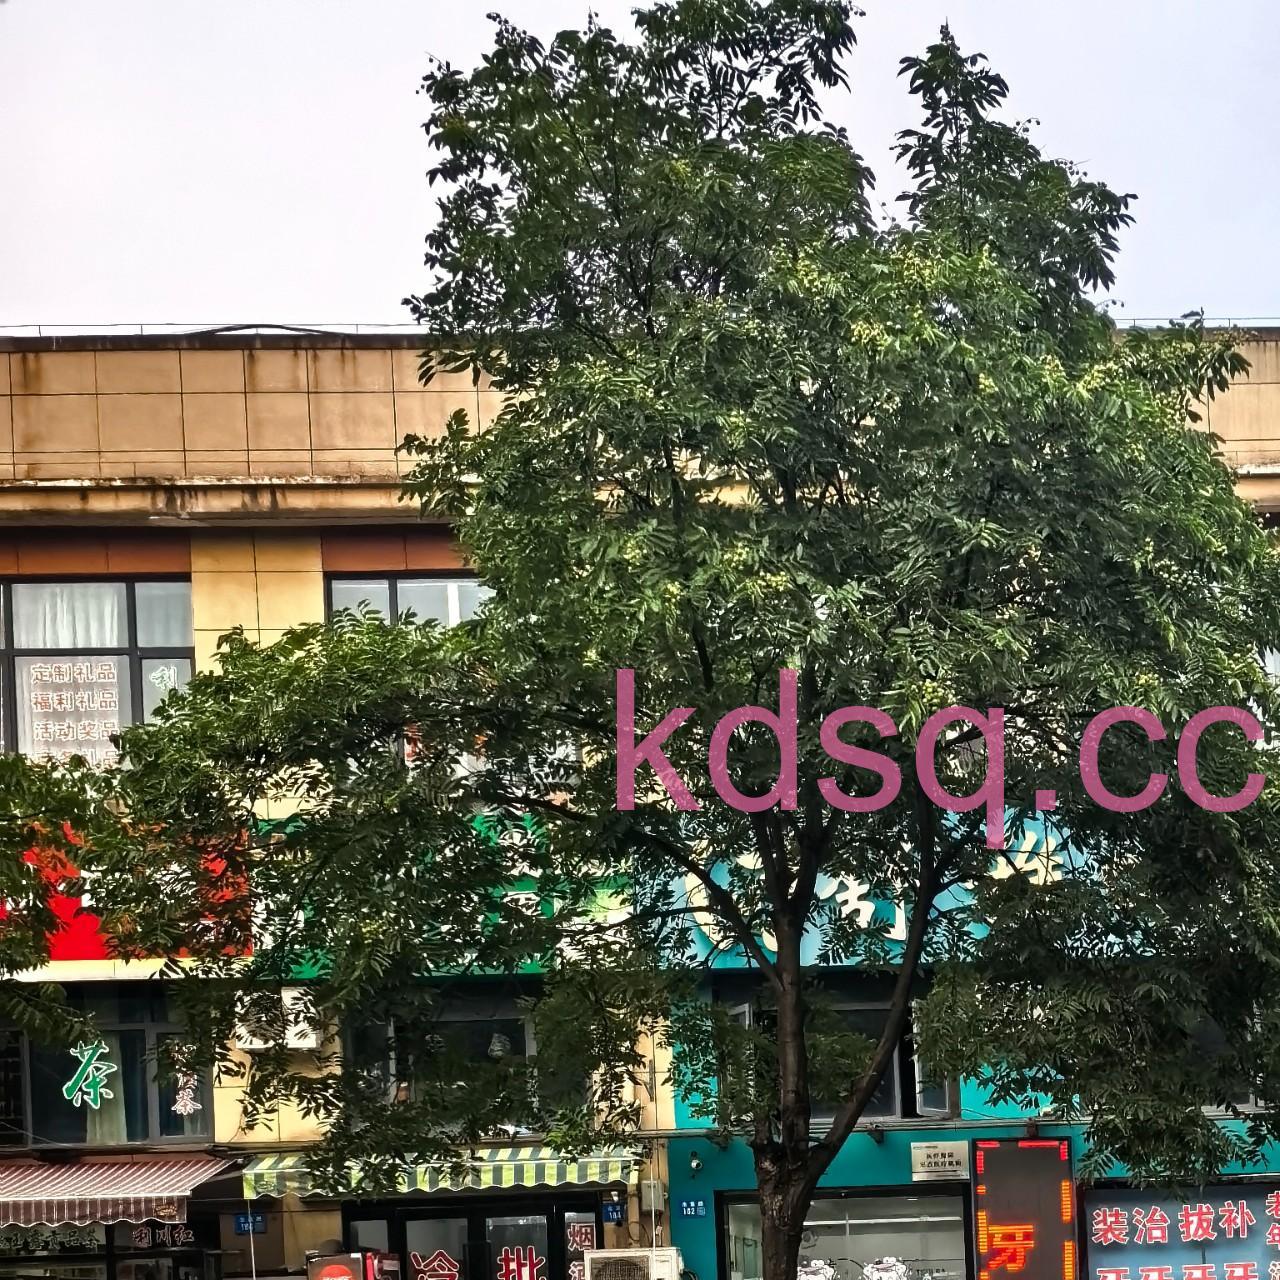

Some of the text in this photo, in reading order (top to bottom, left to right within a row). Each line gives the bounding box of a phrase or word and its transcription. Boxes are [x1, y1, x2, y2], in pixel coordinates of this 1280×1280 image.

[31, 662, 117, 683] 定制礼品
[31, 690, 119, 712] 福利礼品
[34, 720, 120, 741] 活动奖品
[62, 1040, 118, 1109] 茶
